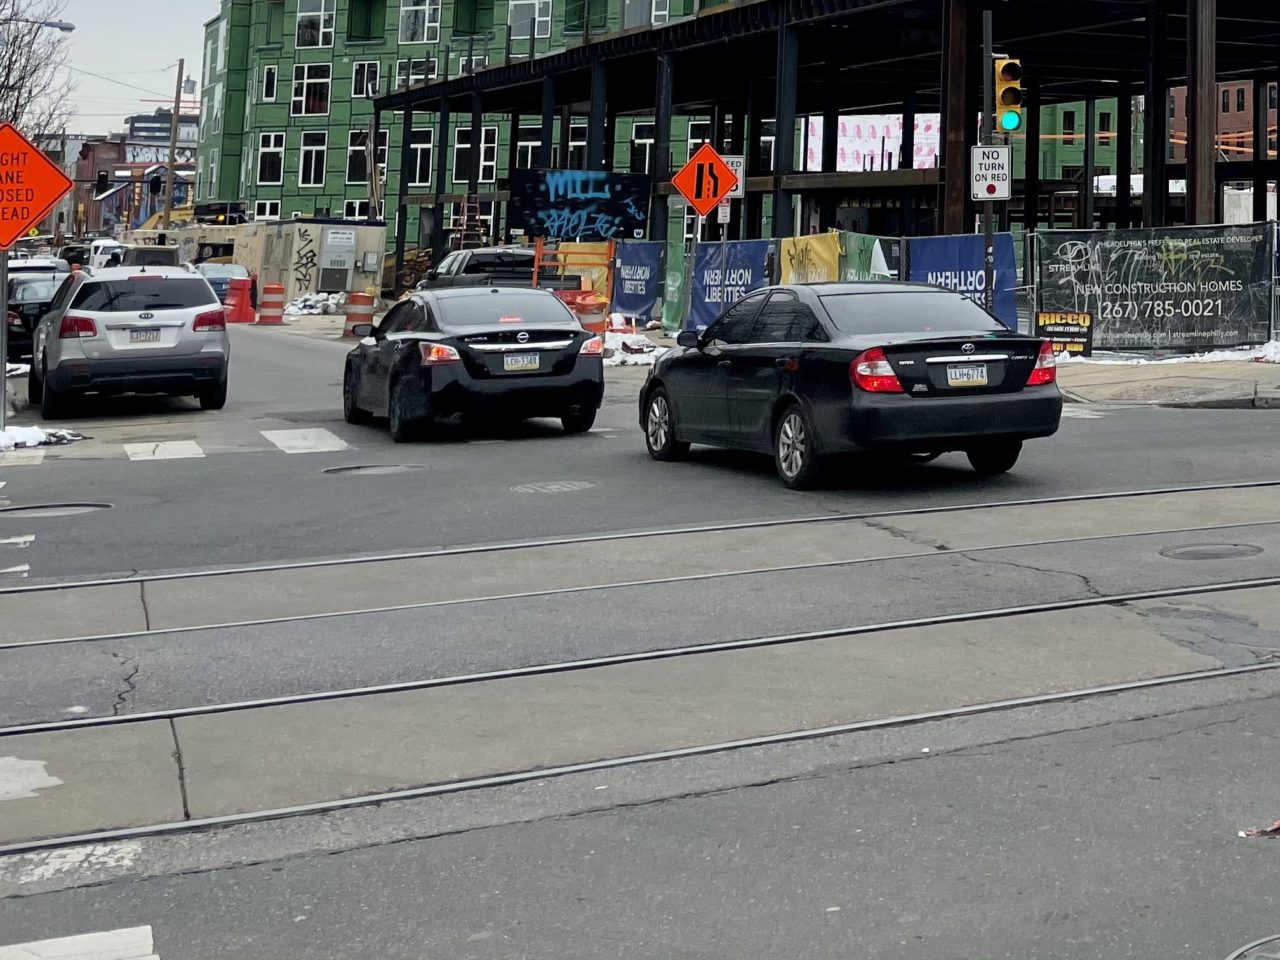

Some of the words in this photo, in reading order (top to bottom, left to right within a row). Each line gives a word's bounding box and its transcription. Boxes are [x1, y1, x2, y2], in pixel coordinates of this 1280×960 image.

[0, 151, 29, 166] GHT
[982, 150, 999, 160] NO
[725, 160, 742, 168] EED
[978, 162, 1005, 171] TURN
[975, 173, 988, 182] ON
[991, 173, 1008, 182] RED
[2, 206, 30, 221] EAD
[1201, 236, 1225, 245] ESTATE
[1226, 234, 1263, 244] DEVELOPER
[1076, 284, 1101, 295] NEW
[1104, 281, 1197, 295] CONSTRUCTION
[1200, 279, 1243, 292] HOMES
[1098, 301, 1138, 320] (267)
[1144, 298, 1223, 317] 785-0021
[1038, 312, 1090, 327] RICCO
